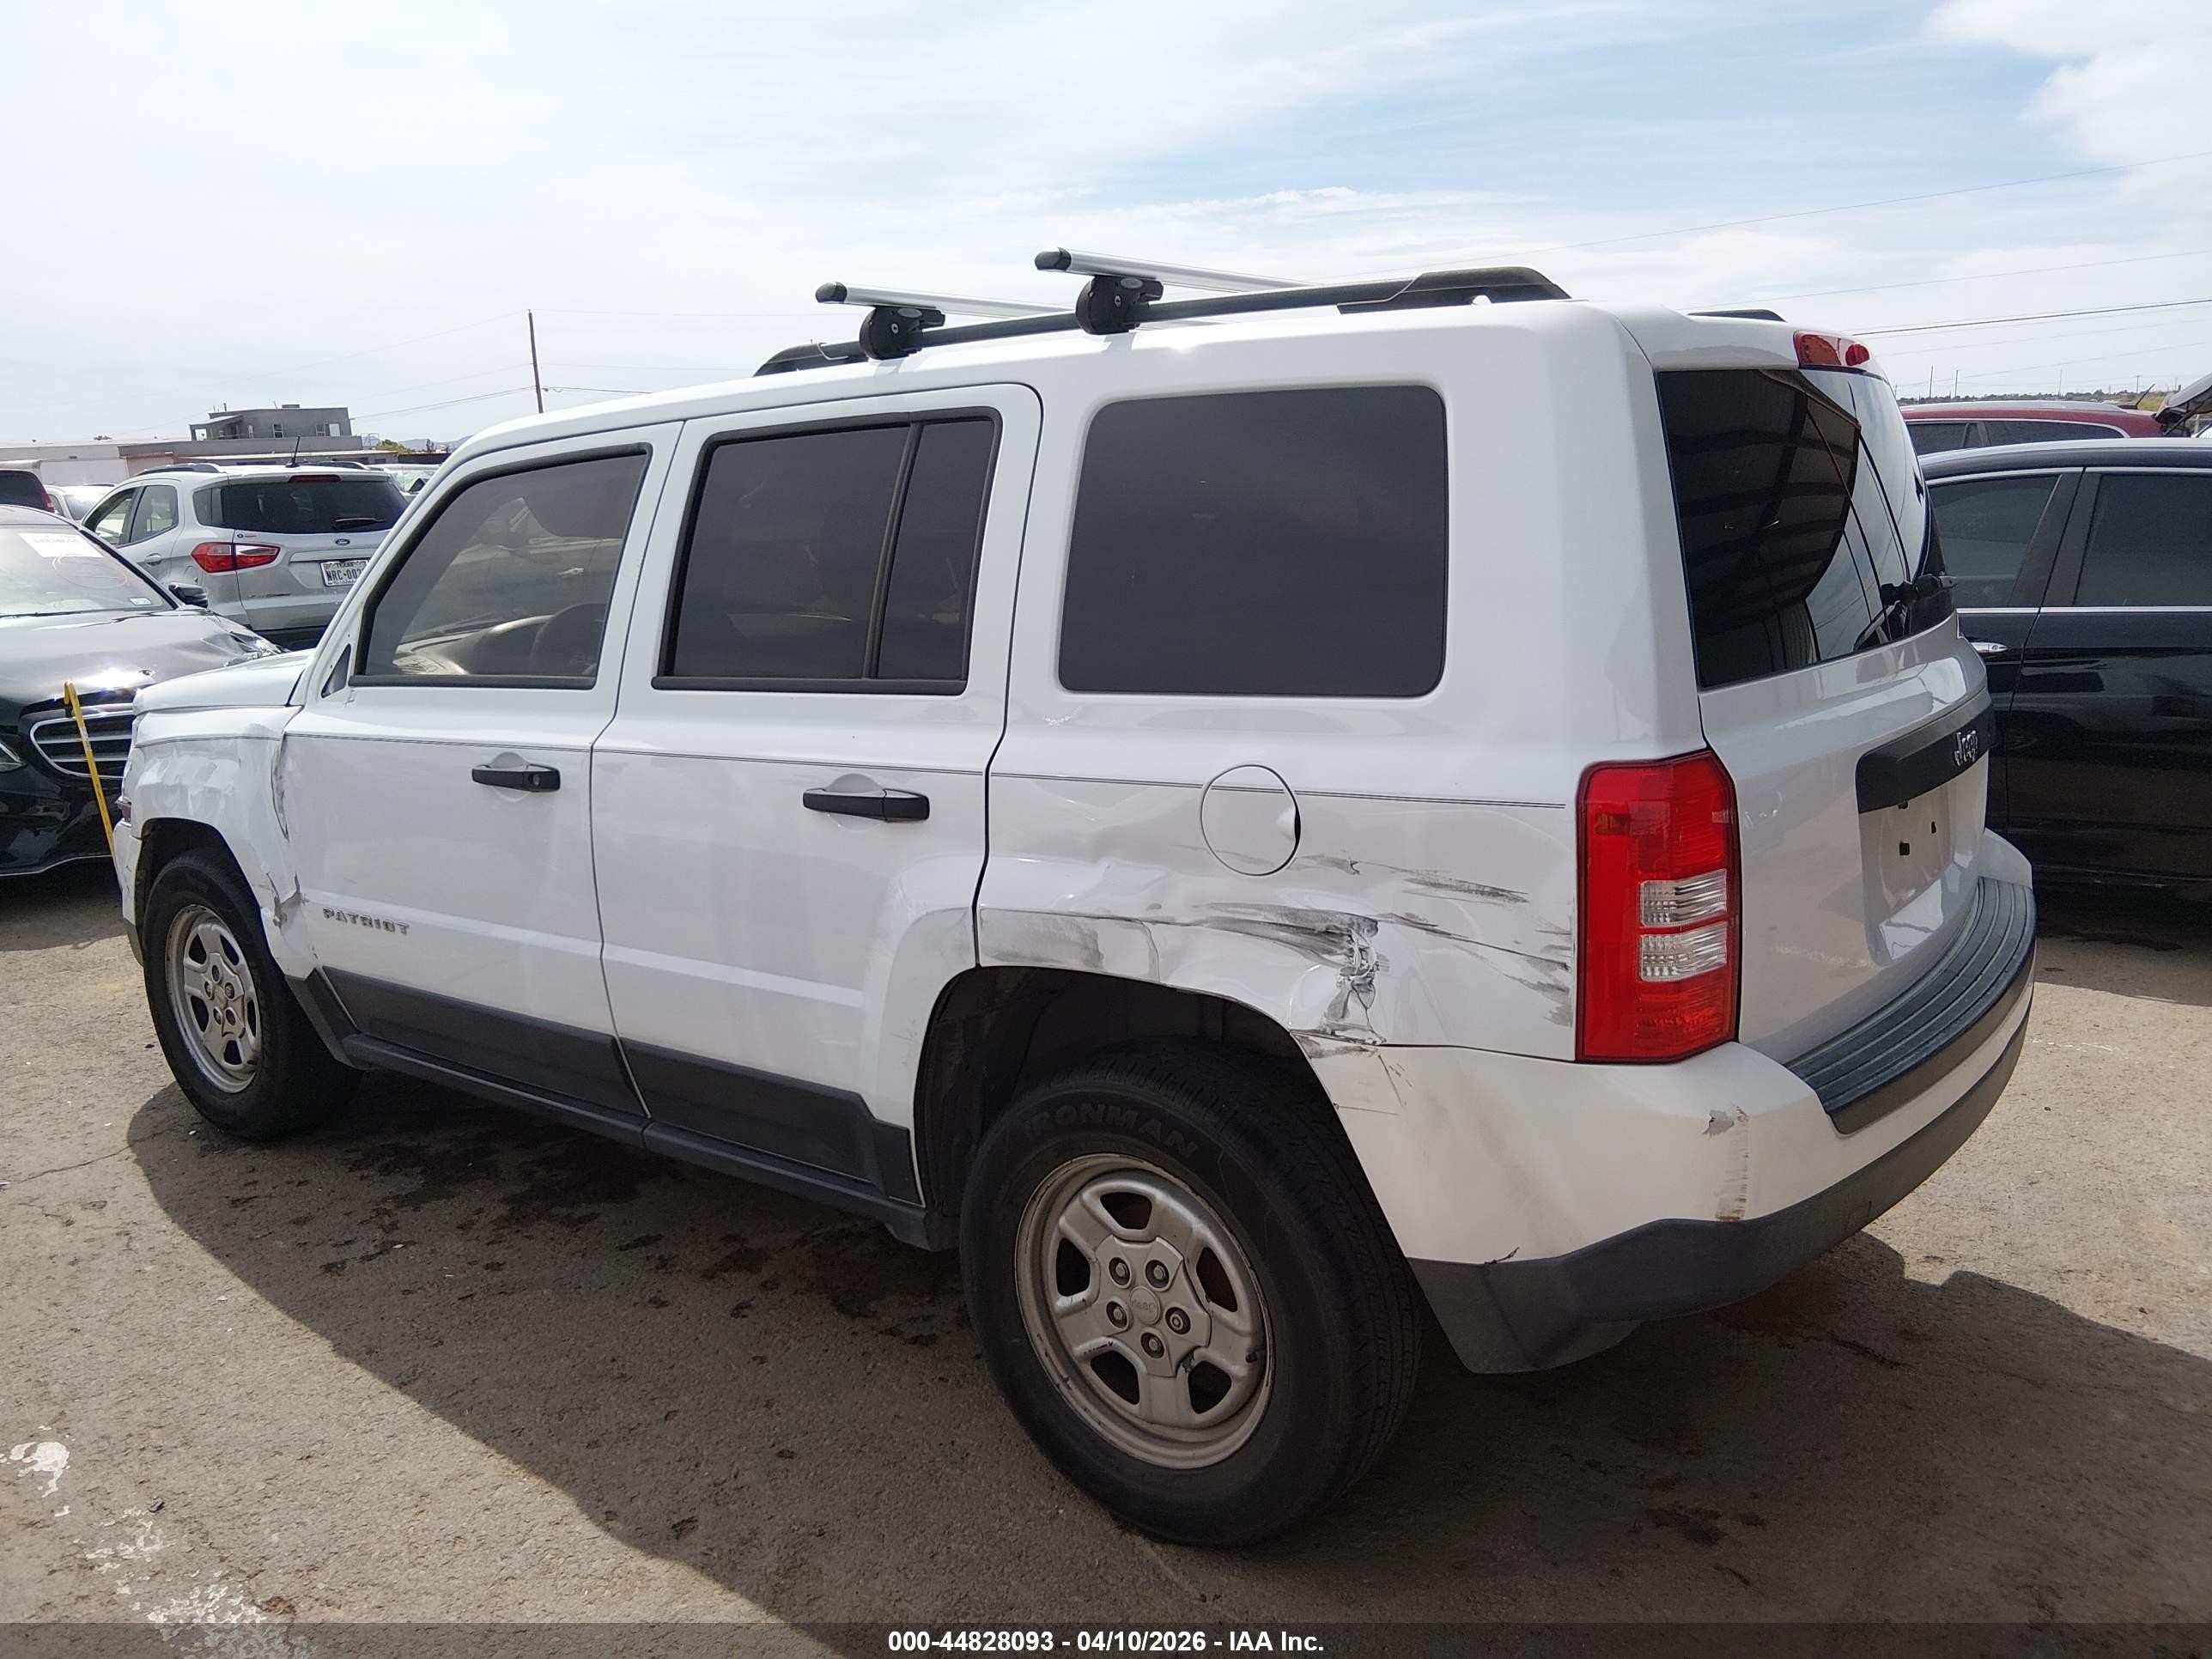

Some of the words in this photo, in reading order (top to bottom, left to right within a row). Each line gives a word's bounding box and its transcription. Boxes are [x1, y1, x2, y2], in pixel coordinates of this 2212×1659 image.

[1954, 730, 1978, 766] Jeep
[322, 907, 410, 935] PATRIOT
[1024, 1102, 1199, 1159] IRONMAN
